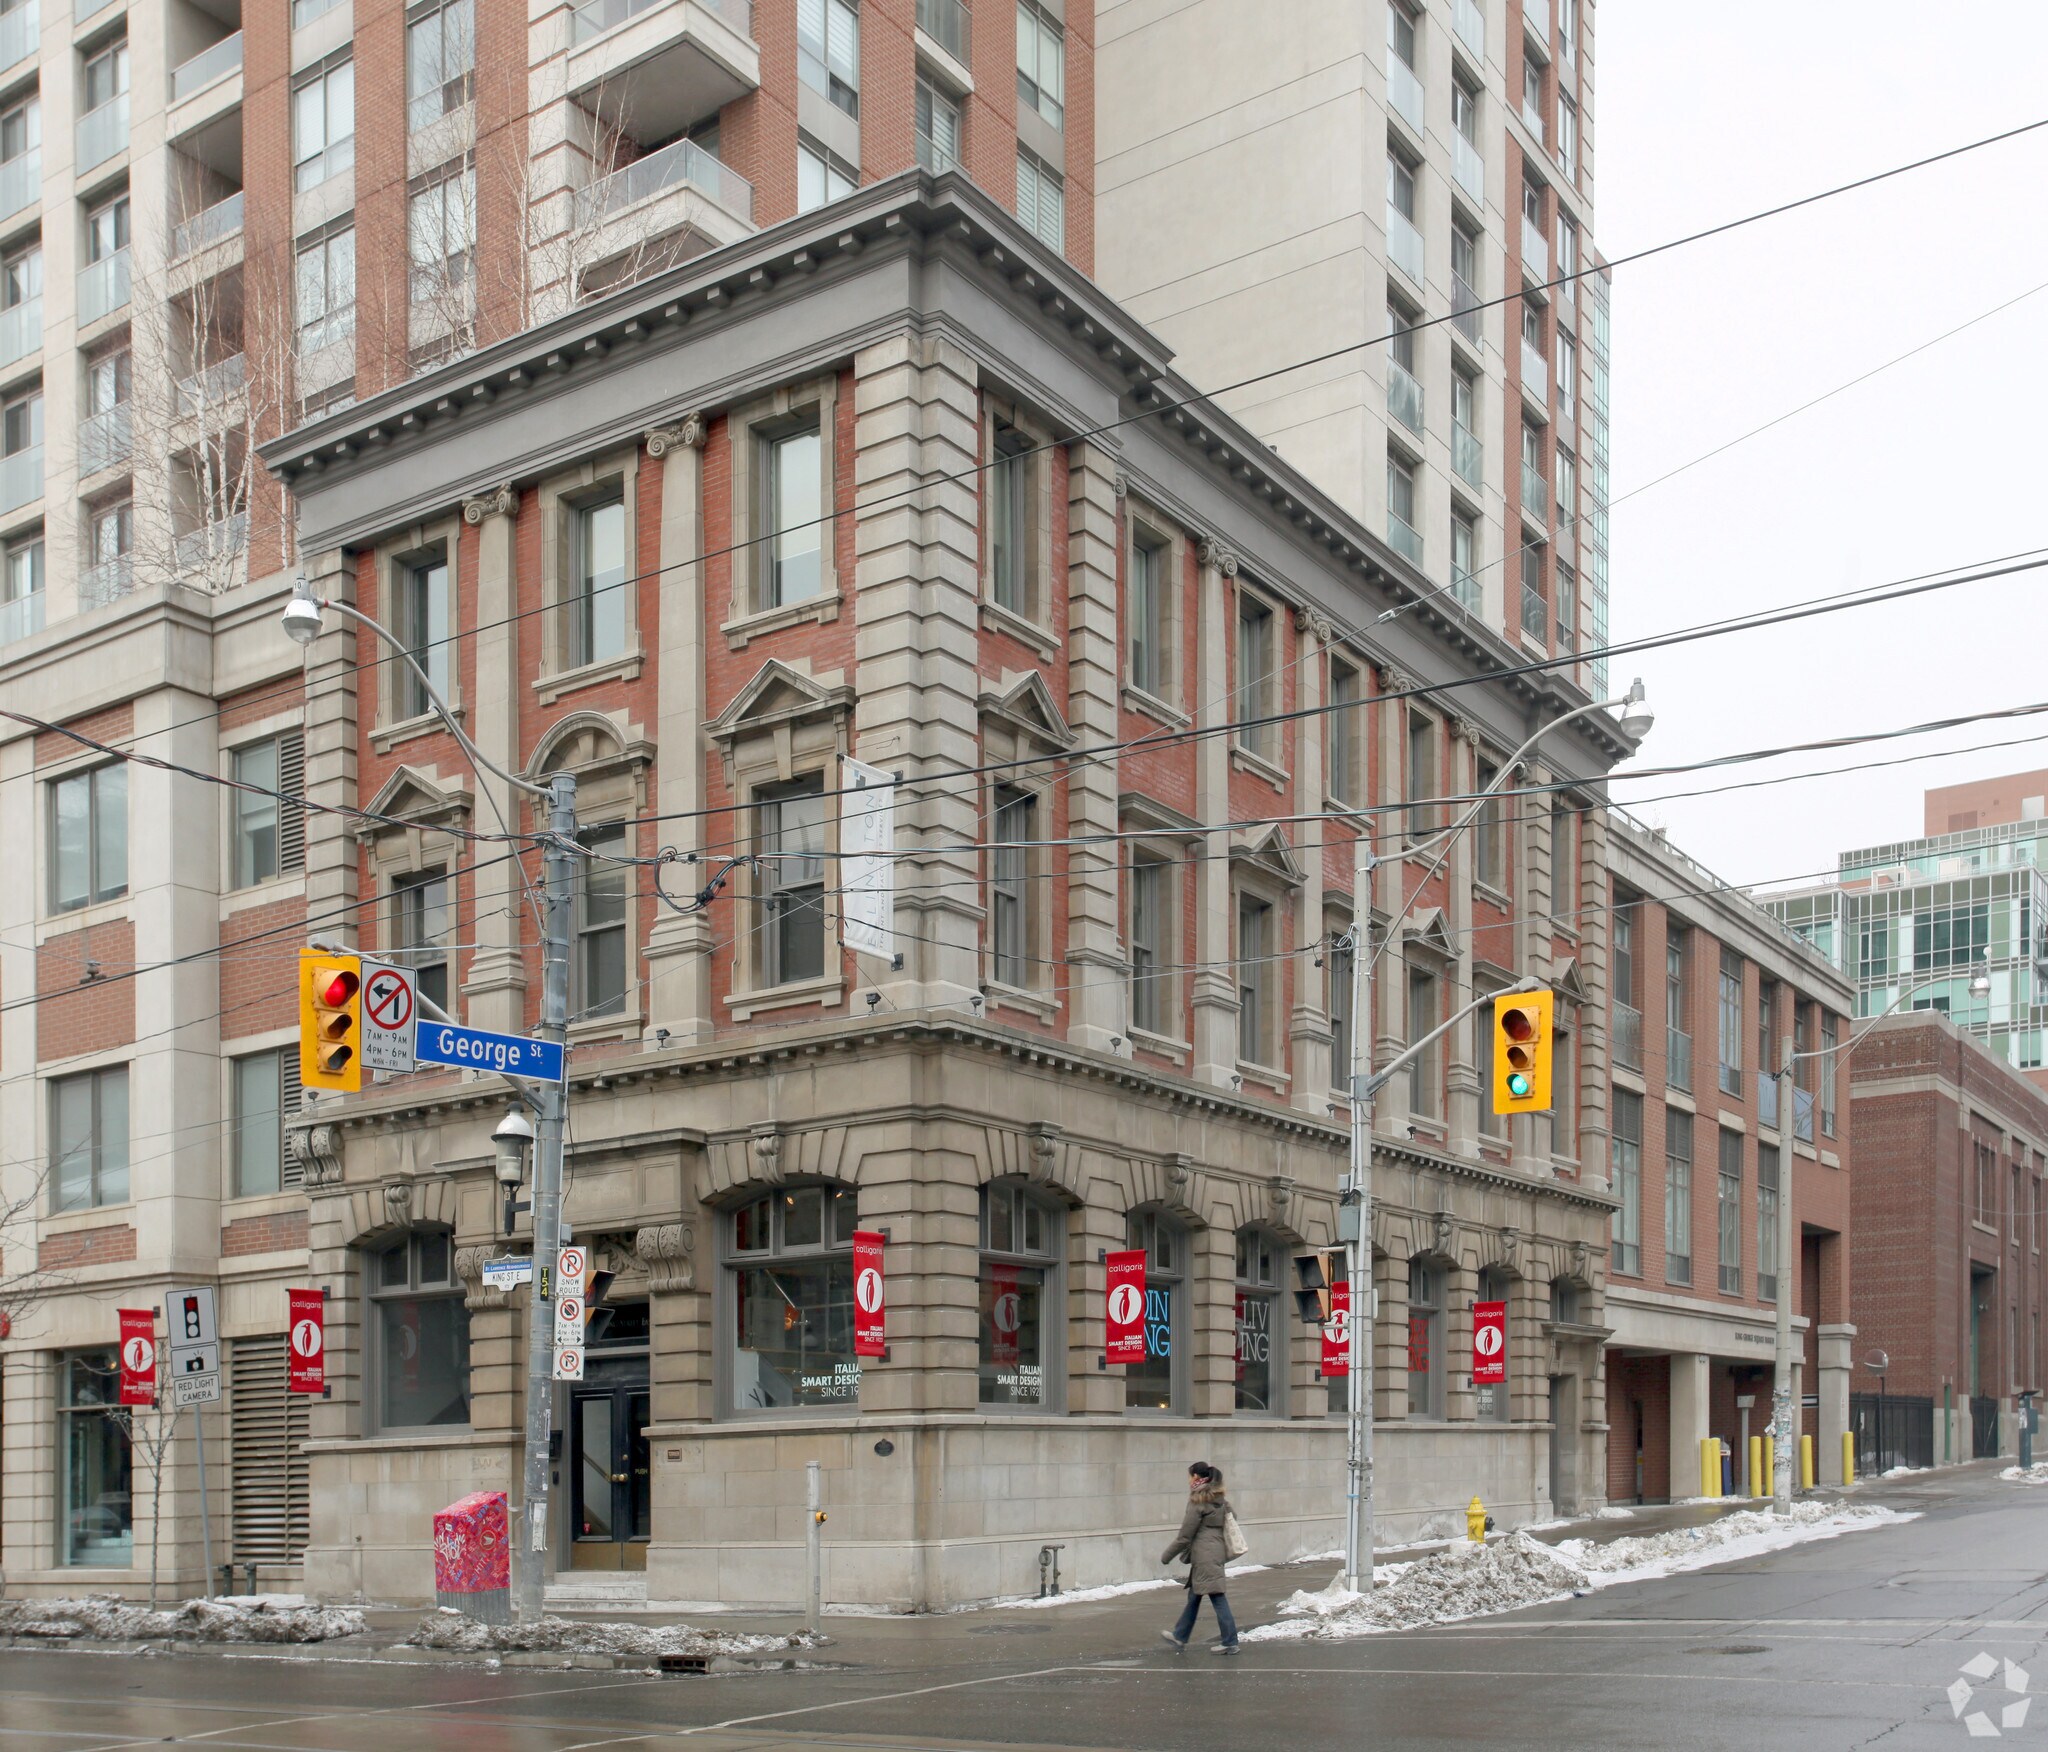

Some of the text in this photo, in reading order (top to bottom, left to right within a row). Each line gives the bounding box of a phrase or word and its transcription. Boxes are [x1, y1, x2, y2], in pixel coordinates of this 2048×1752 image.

[439, 1028, 521, 1070] George
[1108, 1263, 1143, 1273] calligaris
[541, 1267, 549, 1297] T54
[561, 1278, 580, 1286] SNOW
[559, 1286, 580, 1294] ROUTE
[1242, 1300, 1269, 1330] LIV
[1240, 1331, 1269, 1362] ING
[1019, 1364, 1042, 1375] ITALIAN
[178, 1378, 214, 1391] RED LIGHT
[801, 1375, 833, 1387] SMART
[997, 1374, 1042, 1386] SMART DESIGN
[182, 1390, 213, 1402] CAMERA
[821, 1386, 847, 1398] SINCE
[1010, 1386, 1028, 1397] SINCE
